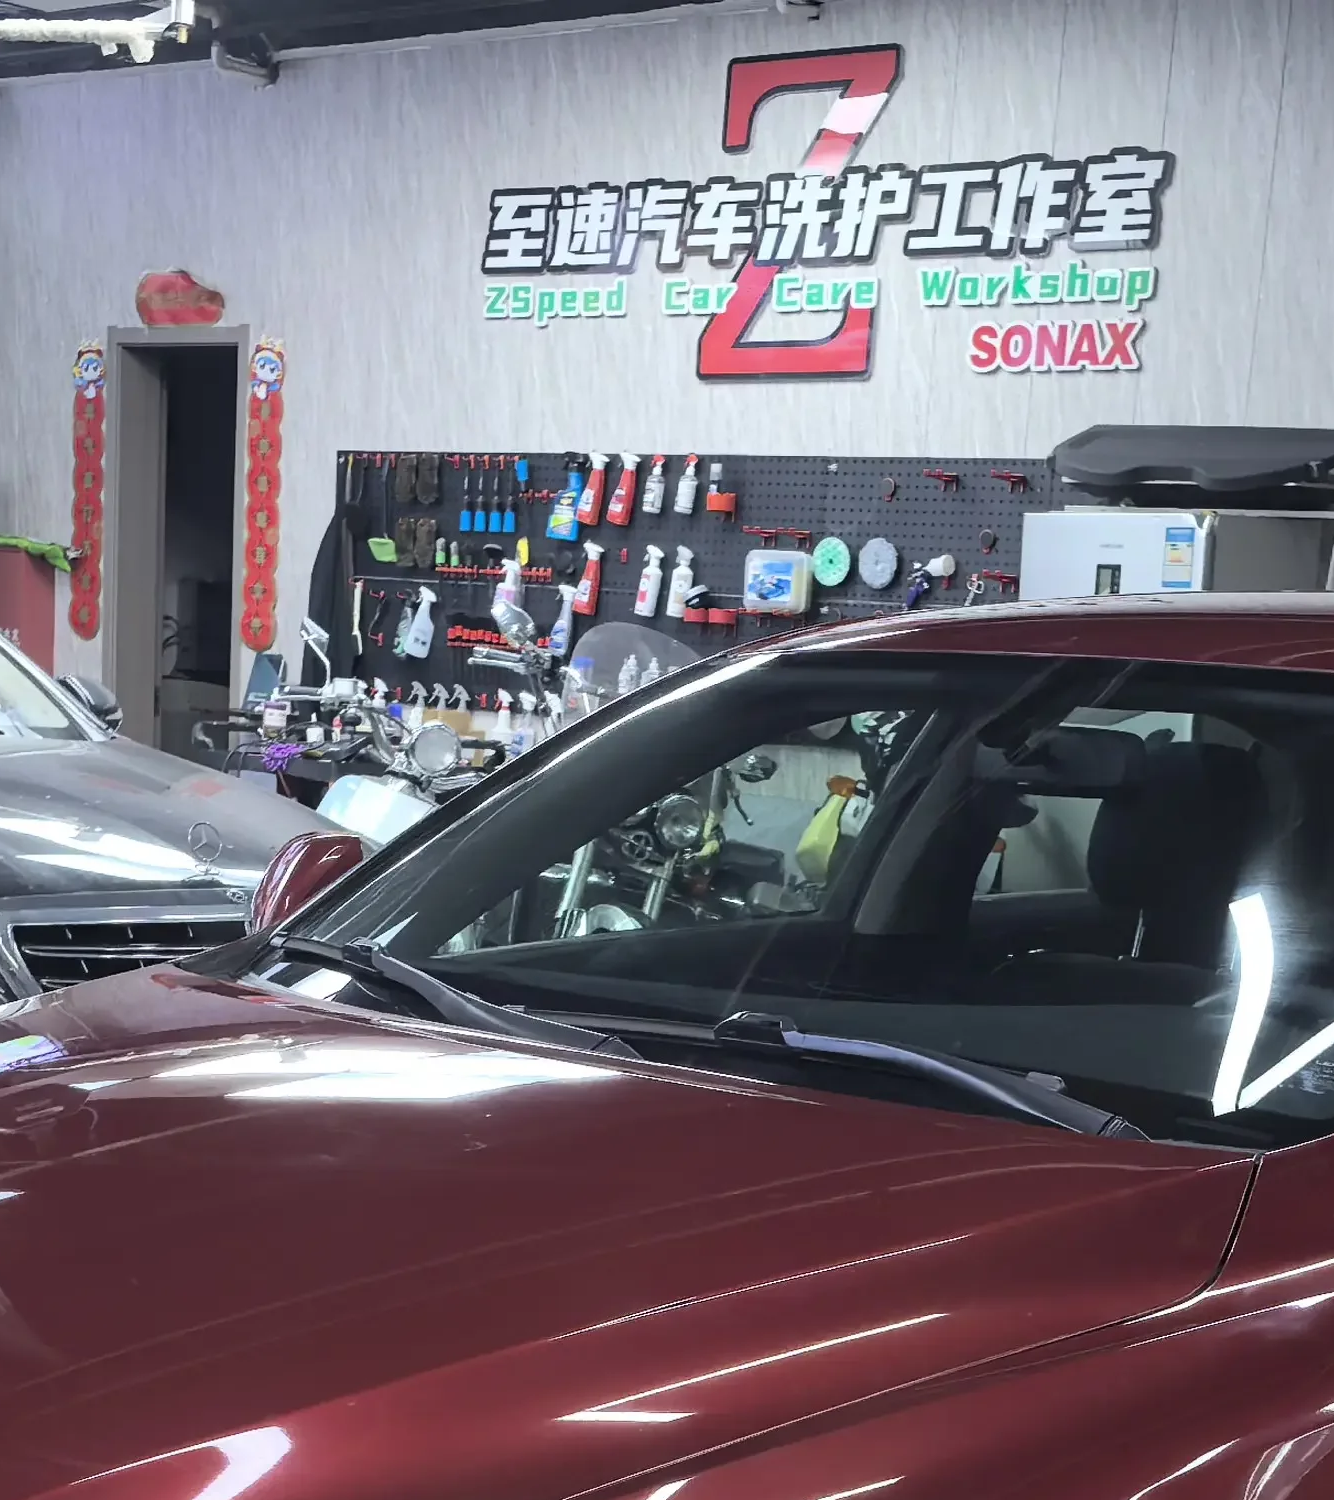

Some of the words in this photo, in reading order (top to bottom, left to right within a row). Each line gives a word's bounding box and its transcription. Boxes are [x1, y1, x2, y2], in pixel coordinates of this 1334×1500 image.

[483, 148, 1173, 273] 至速汽车洗护工作室
[485, 279, 625, 325] ZSpeed
[664, 277, 736, 312] Car
[774, 275, 877, 311] Care
[918, 261, 1155, 307] Workshop
[970, 319, 1141, 371] SONAX
